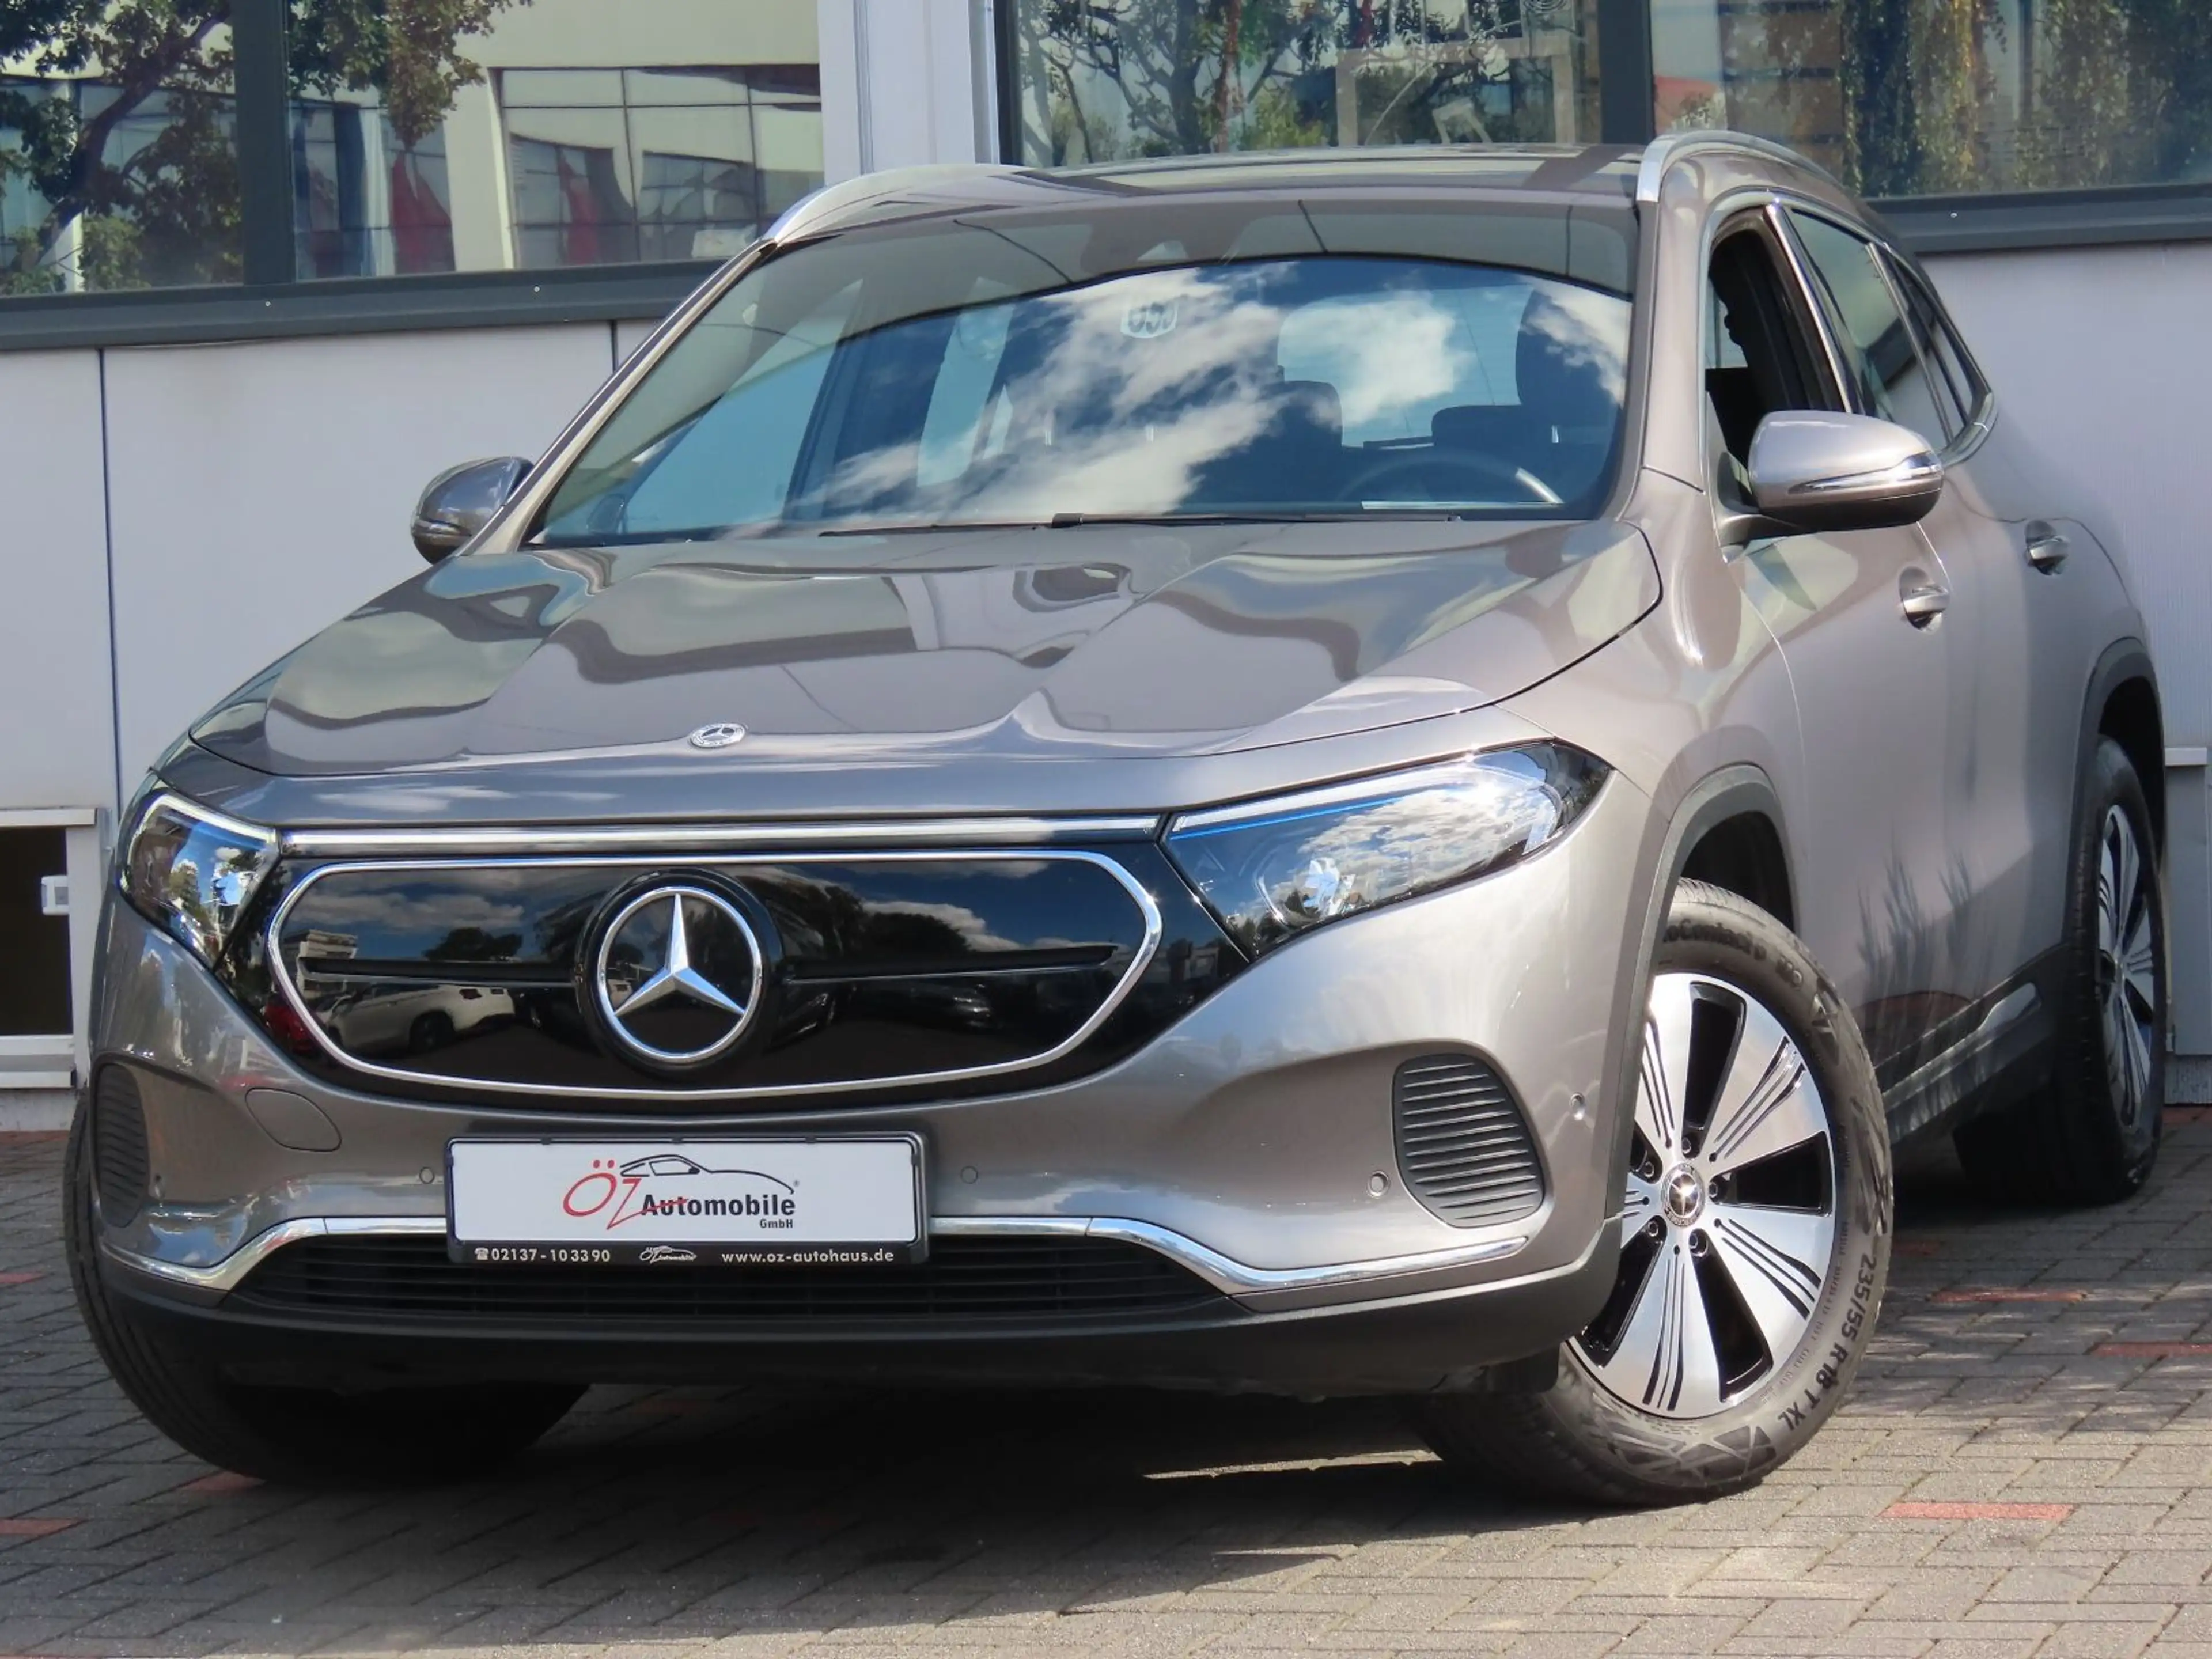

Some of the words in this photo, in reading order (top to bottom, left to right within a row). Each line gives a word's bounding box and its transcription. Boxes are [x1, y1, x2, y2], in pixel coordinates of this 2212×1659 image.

[563, 1159, 687, 1230] ÖZ
[641, 1194, 795, 1216] Automobile
[759, 1218, 794, 1229] GmbH
[721, 1248, 894, 1262] www.oz-autohaus.de
[1840, 1252, 1877, 1342] 235/55
[1829, 1342, 1848, 1363] R
[1804, 1389, 1820, 1409] T
[1778, 1402, 1806, 1431] XL
